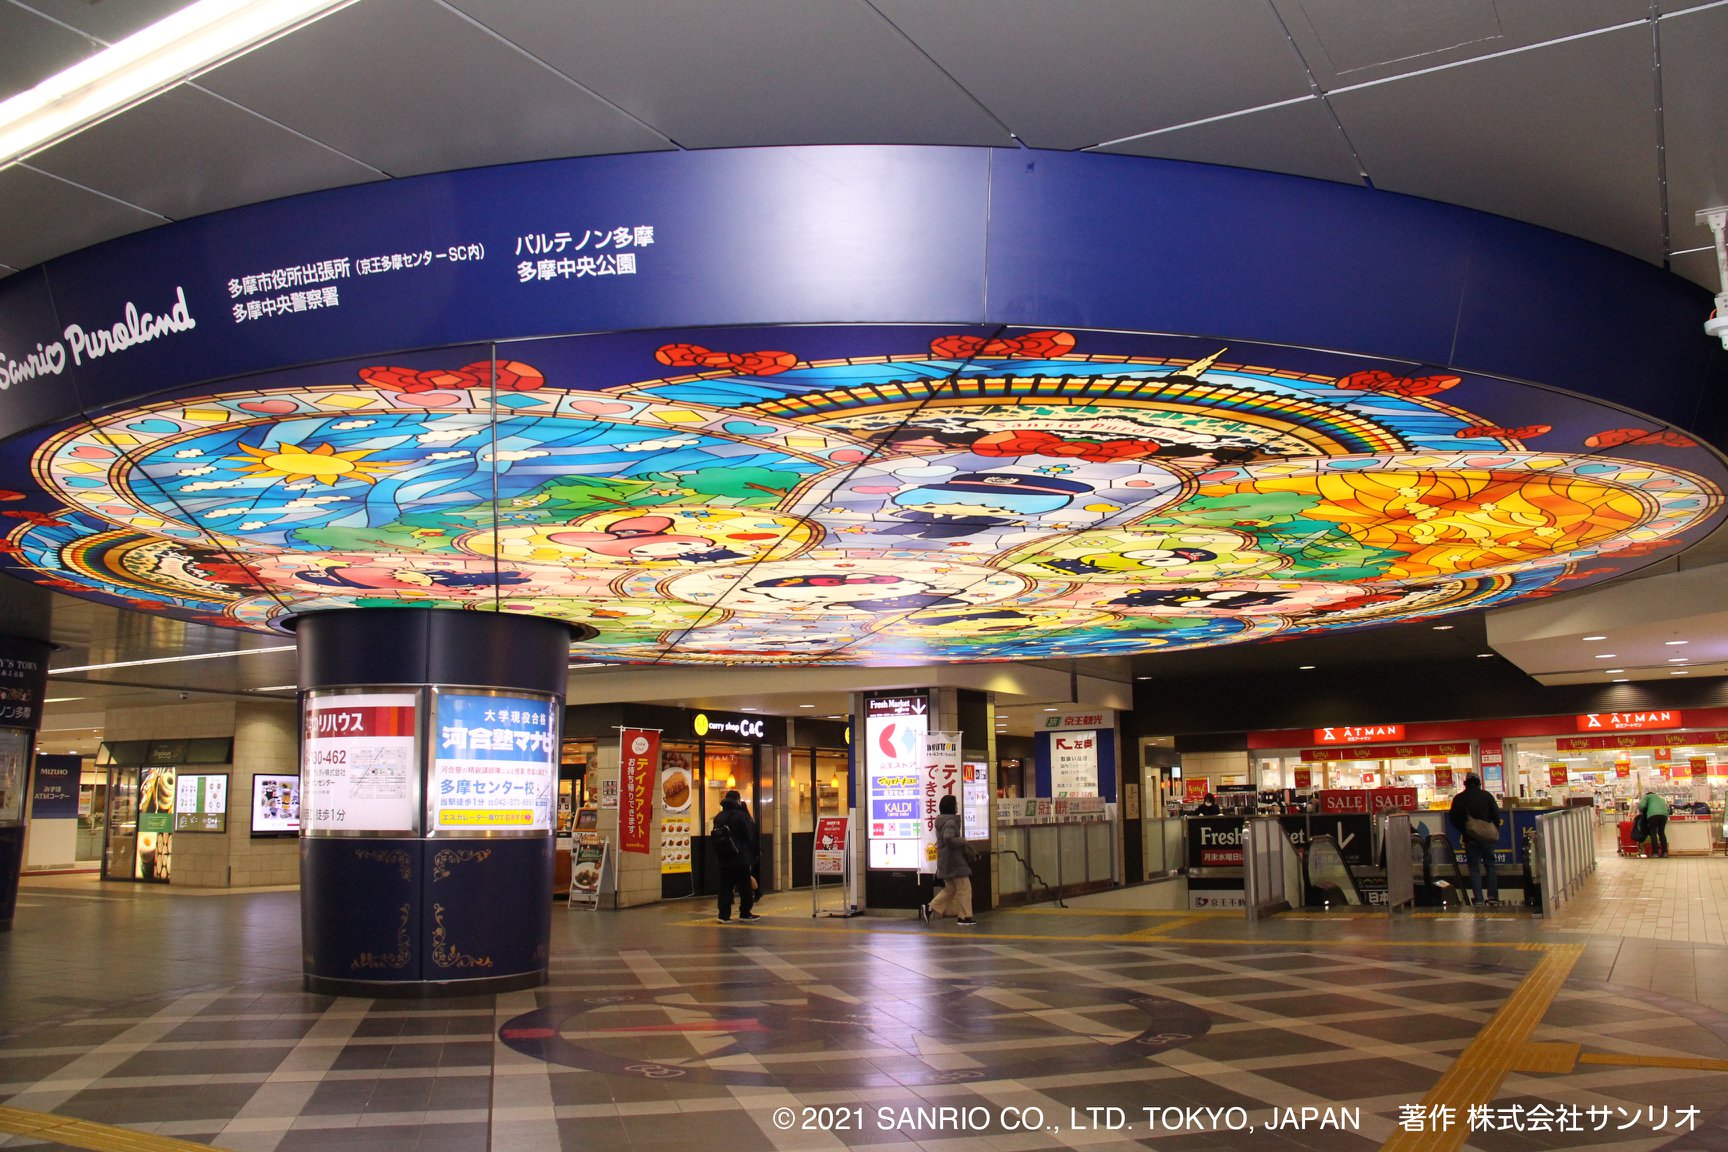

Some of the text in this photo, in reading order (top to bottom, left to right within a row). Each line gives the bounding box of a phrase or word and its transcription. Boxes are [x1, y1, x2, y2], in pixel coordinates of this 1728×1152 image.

[515, 225, 655, 255] パルテノン多摩
[517, 253, 636, 282] 多摩中央公園
[232, 286, 339, 323] 多摩中央警察署
[0, 286, 196, 390] Sanrio Puroland
[996, 421, 1082, 430] Sanrio
[870, 699, 910, 709] Fresh Market
[1064, 714, 1103, 726] 京王観光
[708, 719, 764, 738] curry shop C&C
[1074, 739, 1092, 749] 左奥
[440, 779, 534, 795] 多摩センター校
[635, 758, 648, 838] テイクアウト
[1327, 796, 1363, 809] SALE
[1372, 794, 1412, 807] SALE
[885, 802, 912, 812] KALDI
